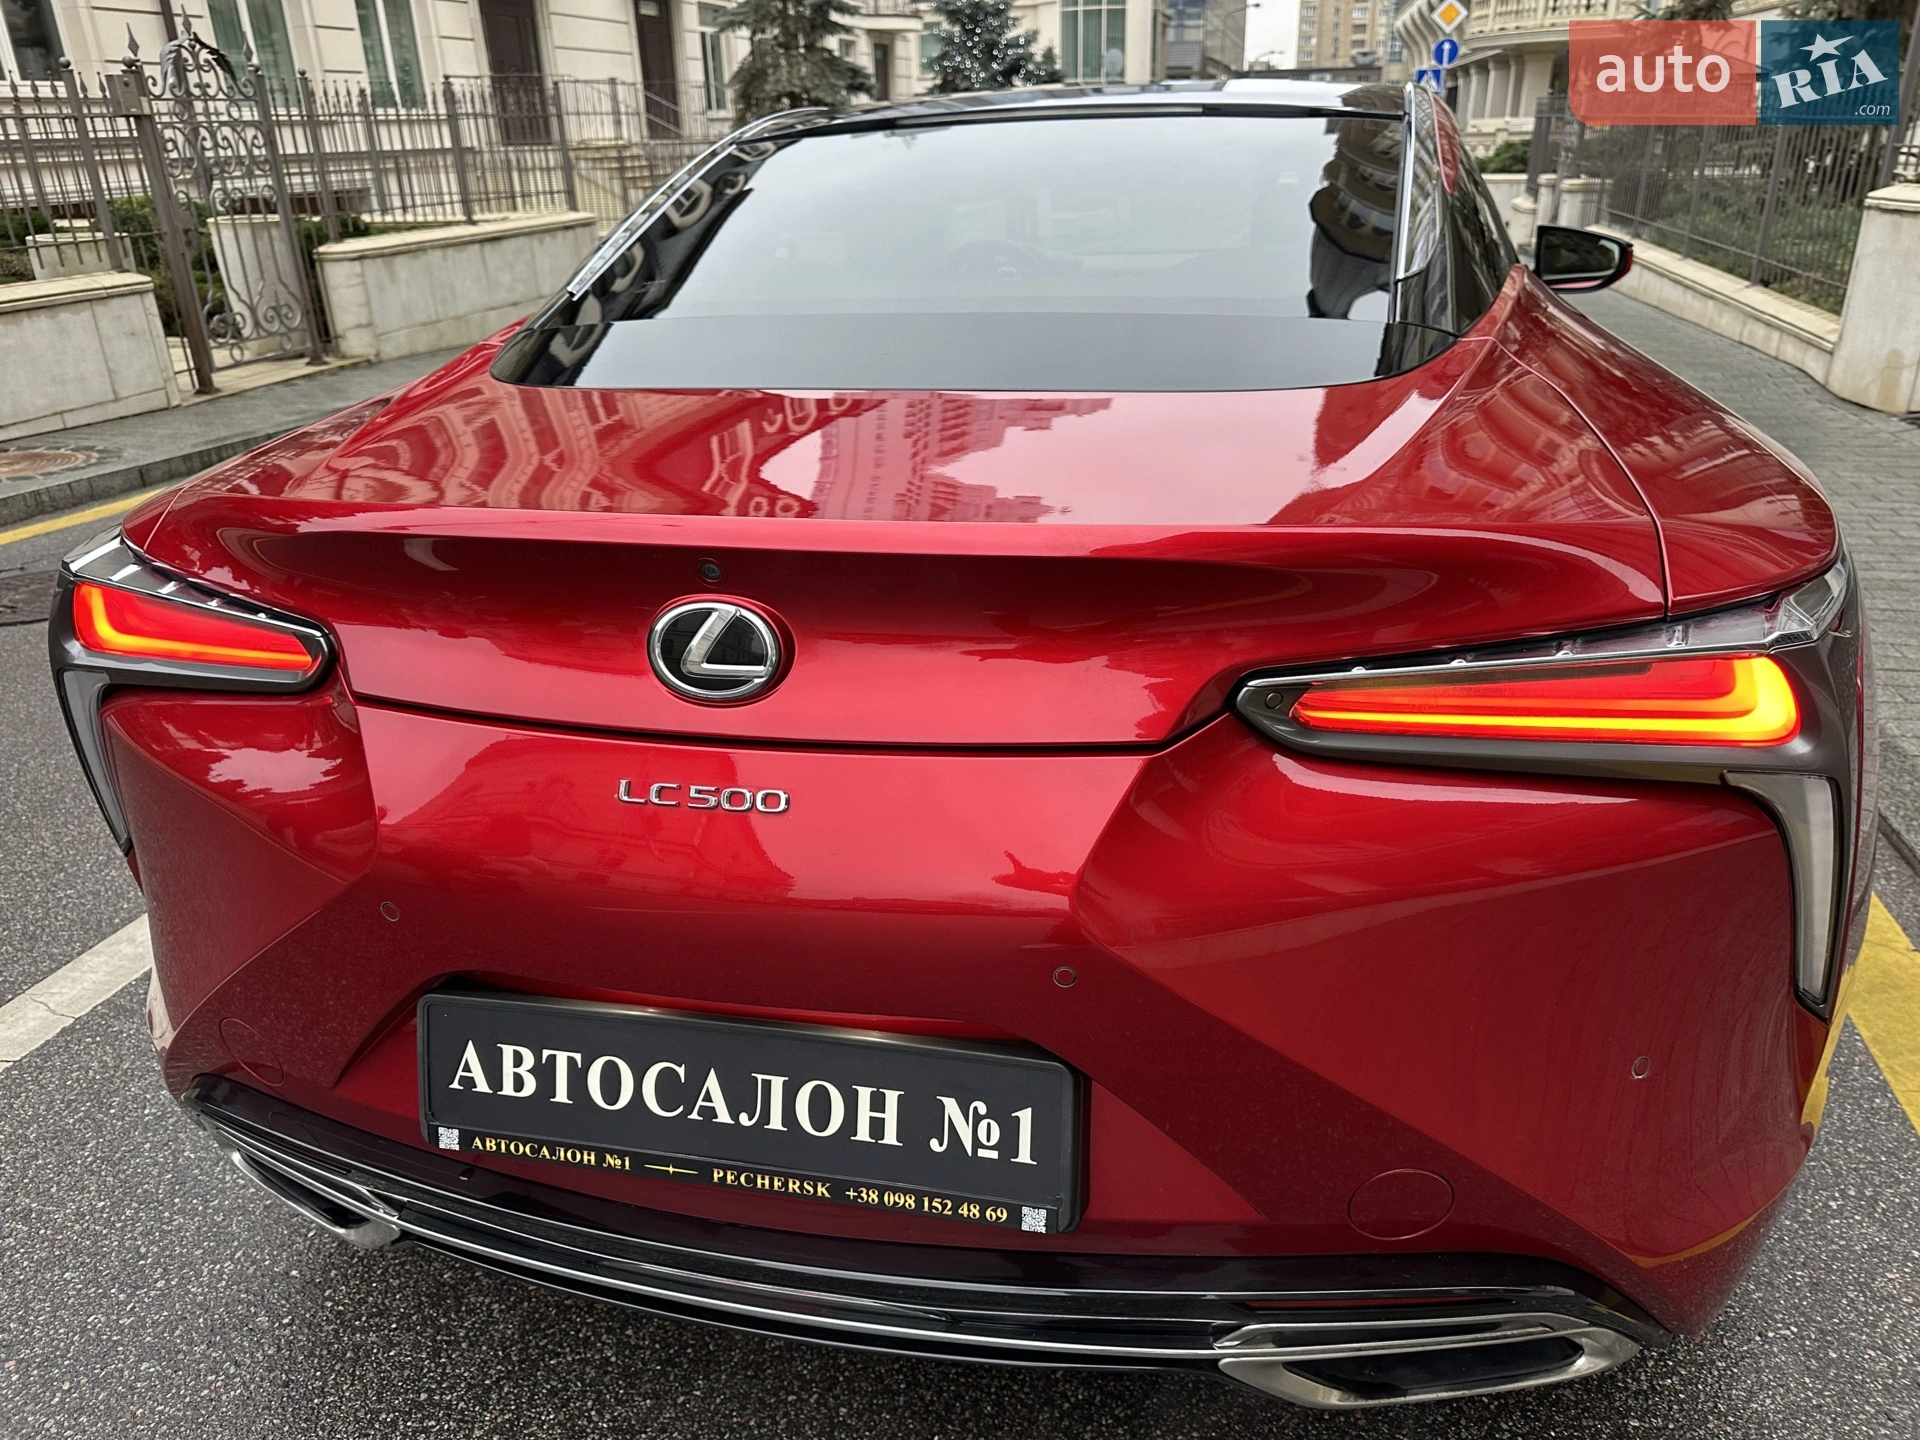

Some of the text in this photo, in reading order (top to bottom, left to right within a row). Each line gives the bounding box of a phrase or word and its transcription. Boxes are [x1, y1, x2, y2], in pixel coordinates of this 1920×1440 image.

[617, 779, 789, 813] LC 500
[449, 1039, 1038, 1165] АВТОСАЛОН №1
[471, 1136, 632, 1171] АВТОСАЛОН №1
[712, 1168, 1008, 1222] PECHERSK +38 098 152 48 69
